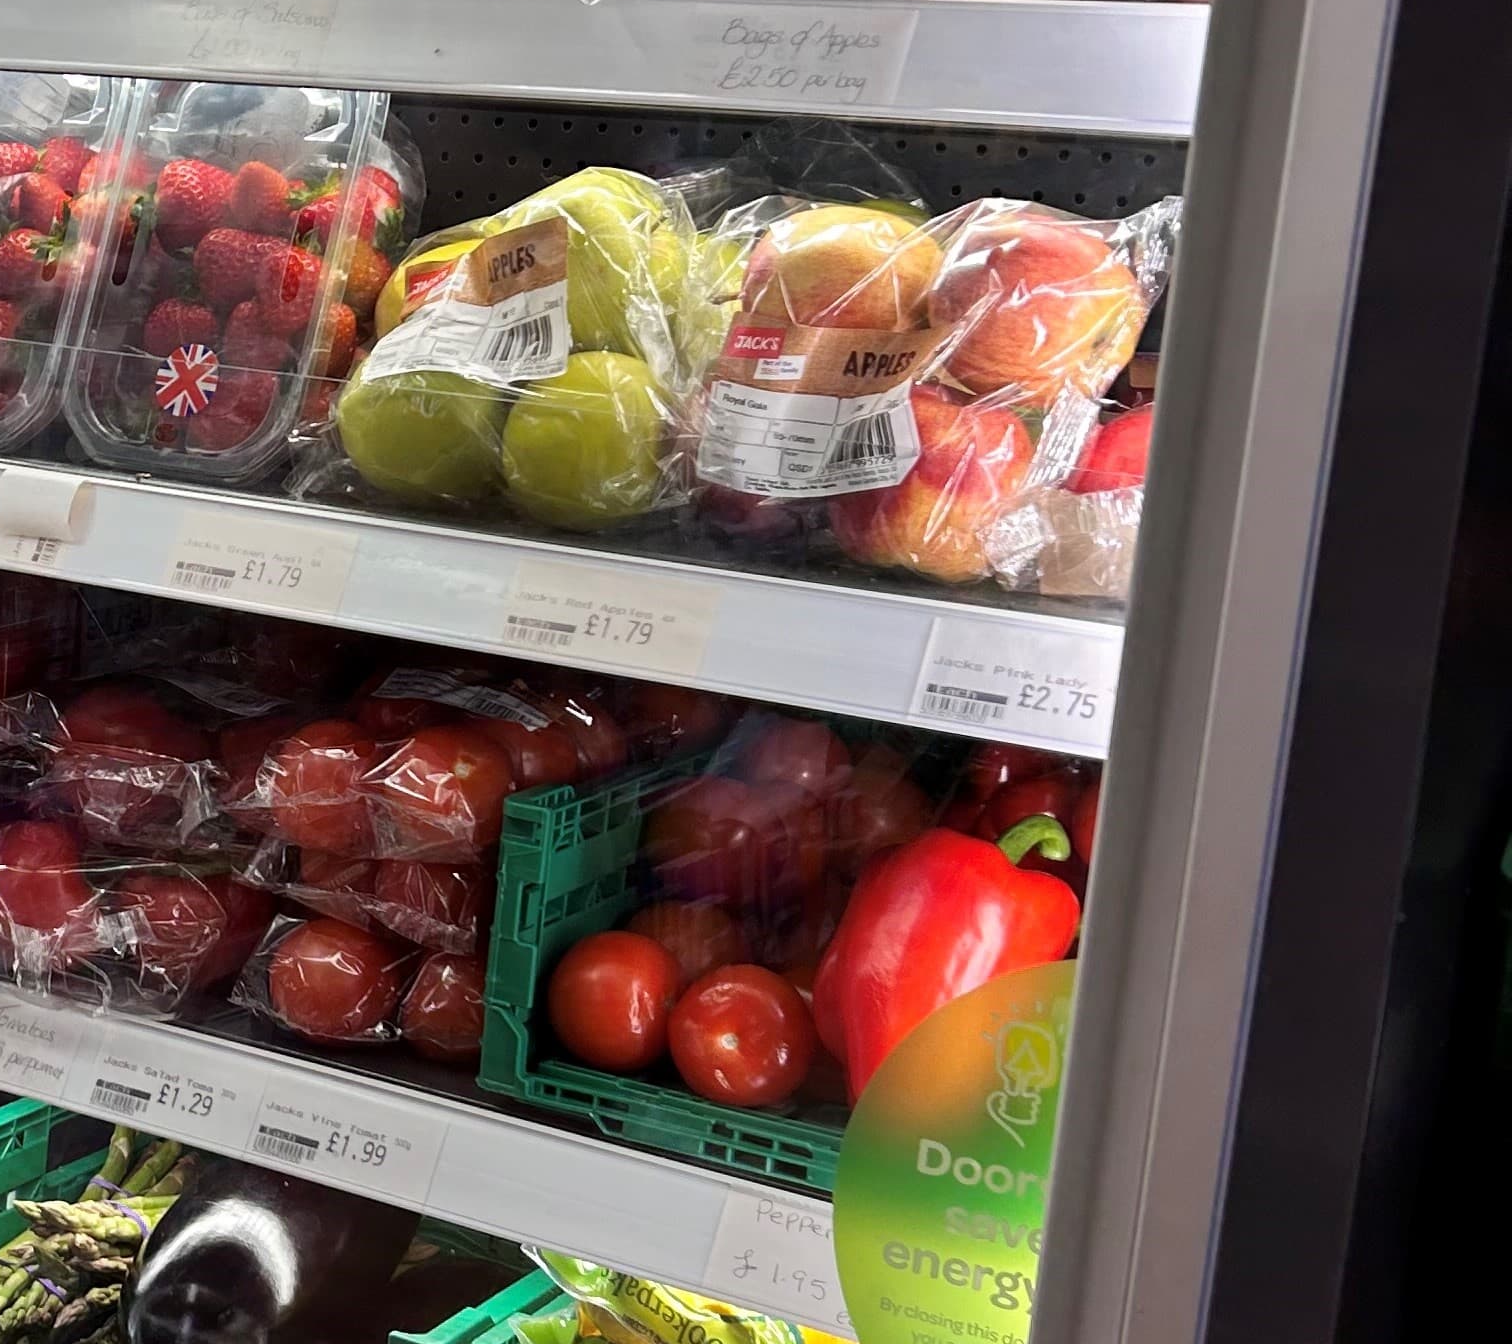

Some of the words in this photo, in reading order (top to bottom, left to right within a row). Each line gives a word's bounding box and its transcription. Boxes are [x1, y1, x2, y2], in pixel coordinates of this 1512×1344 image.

[722, 18, 784, 59] Bags
[791, 19, 824, 53] of
[817, 23, 880, 58] Apples
[800, 73, 832, 94] per
[835, 71, 867, 104] bag
[735, 335, 780, 351] JACK'S
[844, 350, 916, 378] APPLES
[242, 560, 302, 588] £1.79
[584, 613, 654, 645] £1.79
[934, 657, 984, 672] Jacks
[1046, 673, 1088, 689] Lady
[1018, 683, 1099, 719] £2.75
[104, 1056, 137, 1072] Jacks
[144, 1066, 180, 1083] Salad
[157, 1083, 214, 1117] £1.29
[326, 1131, 388, 1167] £1.99
[917, 1139, 1050, 1197] Door
[773, 1263, 828, 1301] 1.95
[880, 1296, 901, 1317] By
[903, 1302, 965, 1337] closing
[967, 1318, 999, 1343] this
